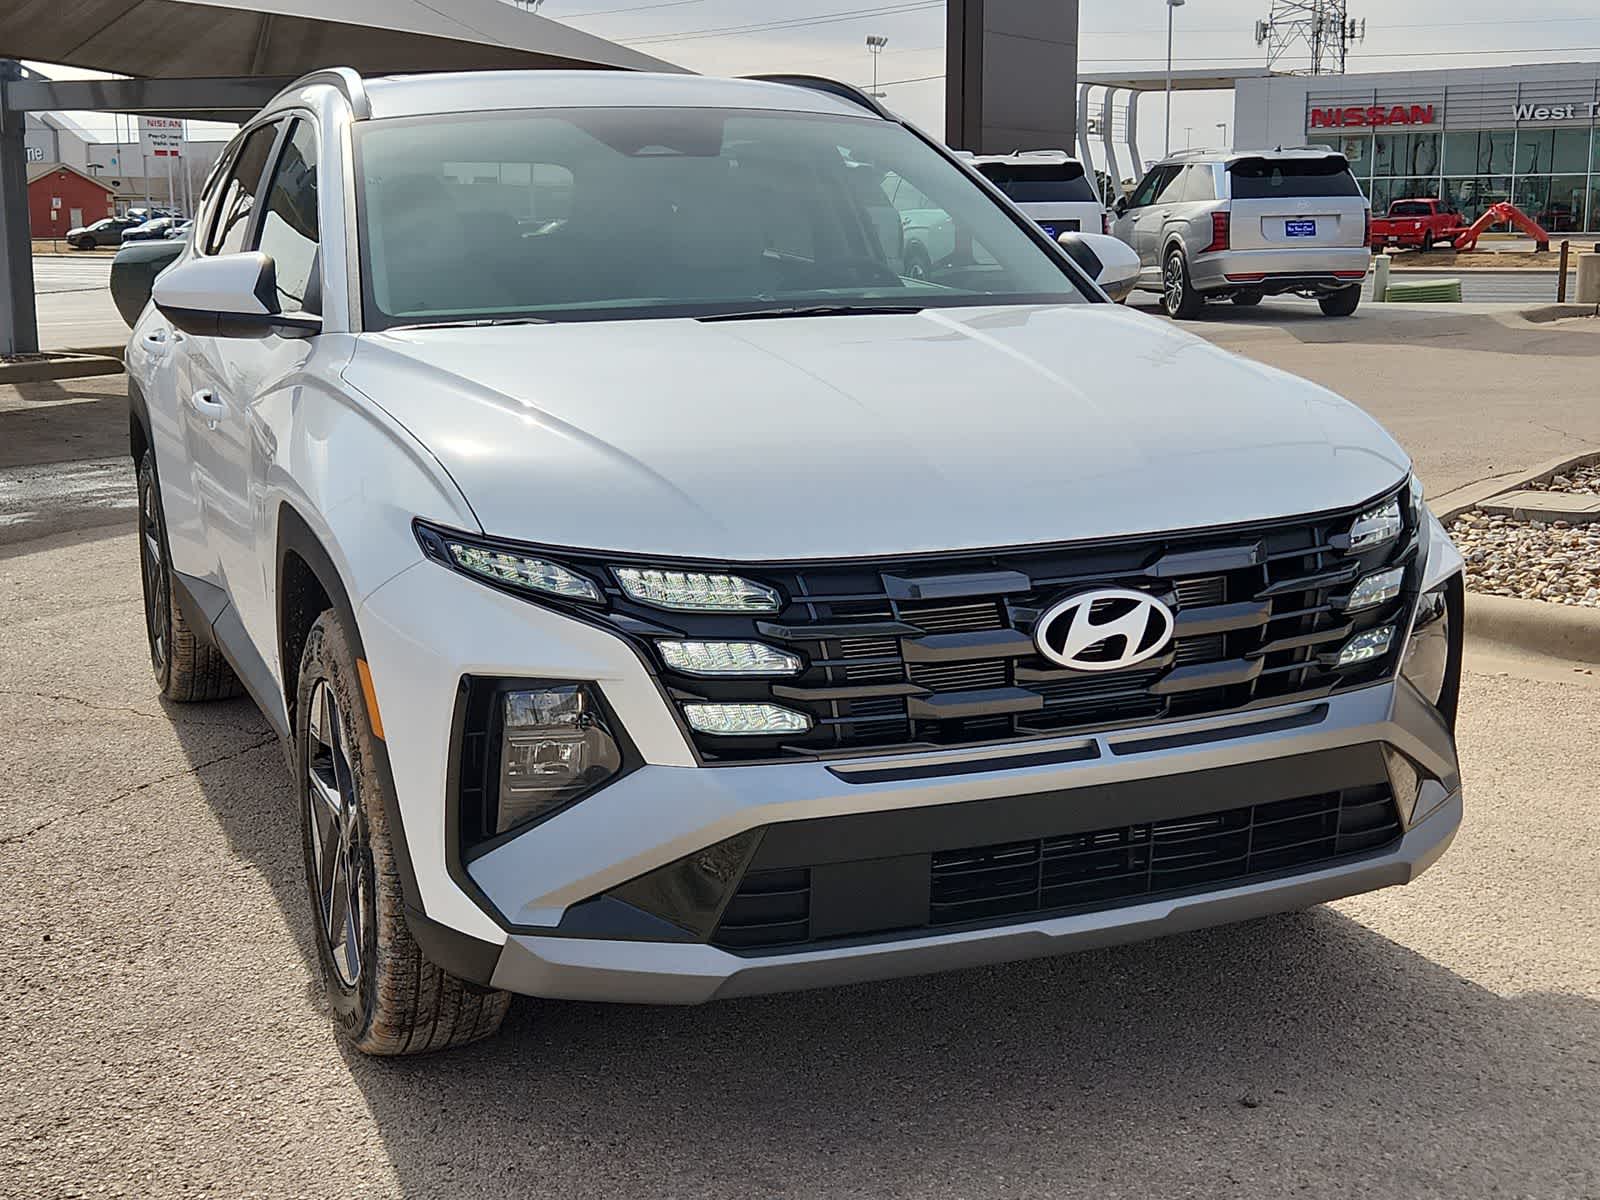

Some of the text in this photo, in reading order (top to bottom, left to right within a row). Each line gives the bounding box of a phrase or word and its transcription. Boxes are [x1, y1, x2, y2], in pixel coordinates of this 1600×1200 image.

[1311, 104, 1433, 128] NISSAN
[1511, 101, 1600, 121] West T
